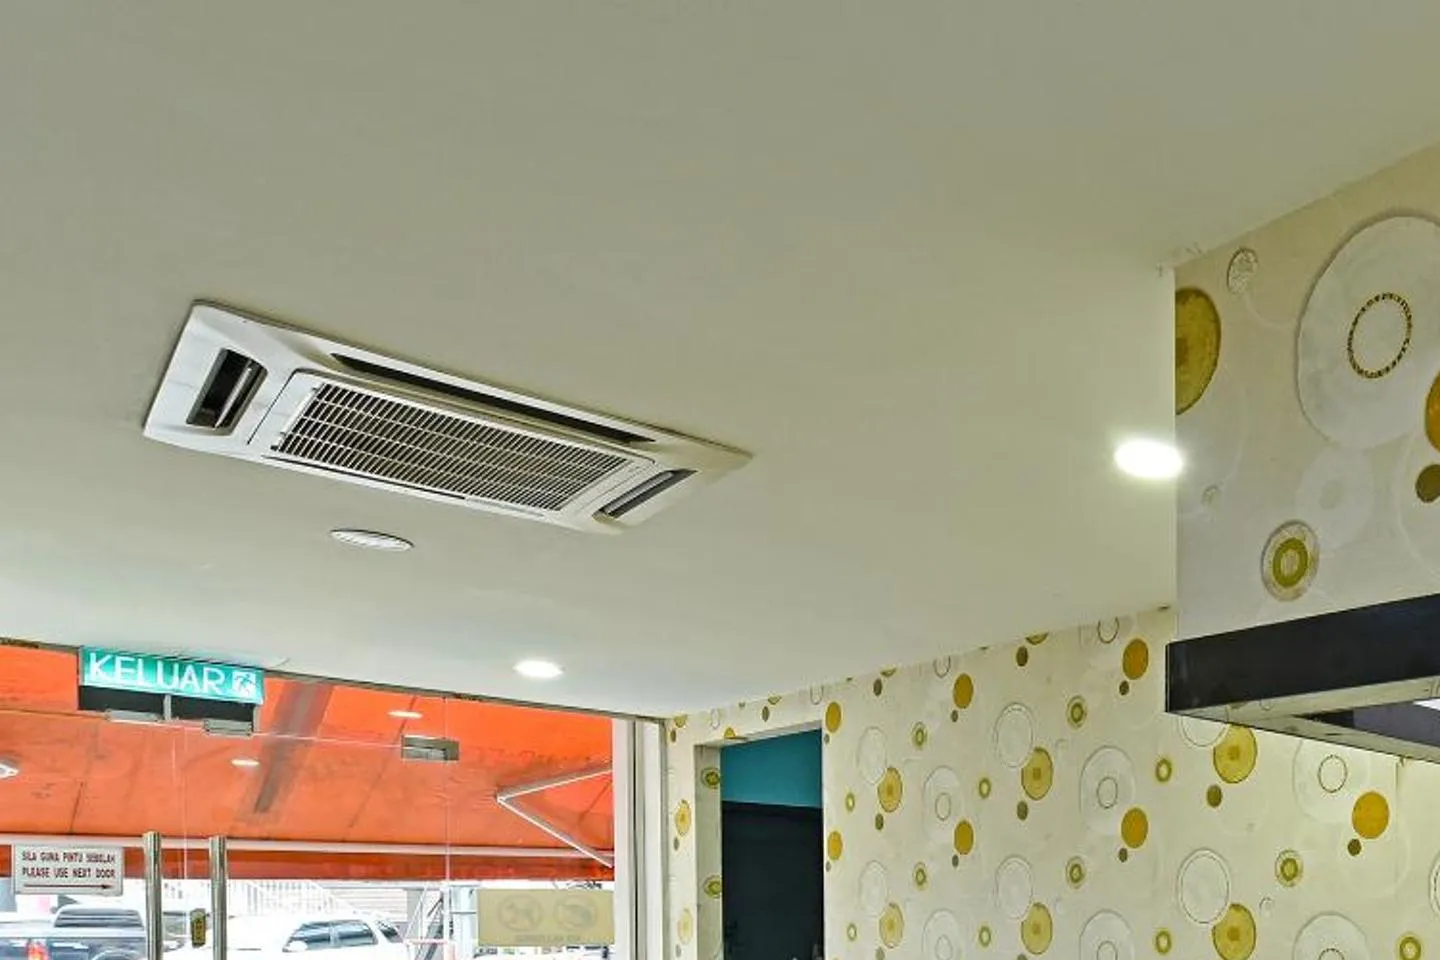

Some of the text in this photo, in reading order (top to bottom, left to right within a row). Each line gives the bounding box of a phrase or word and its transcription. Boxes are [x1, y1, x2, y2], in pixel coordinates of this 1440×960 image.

[89, 652, 226, 694] KELUAR
[22, 867, 116, 878] PLEASE USE NEXT DOOR
